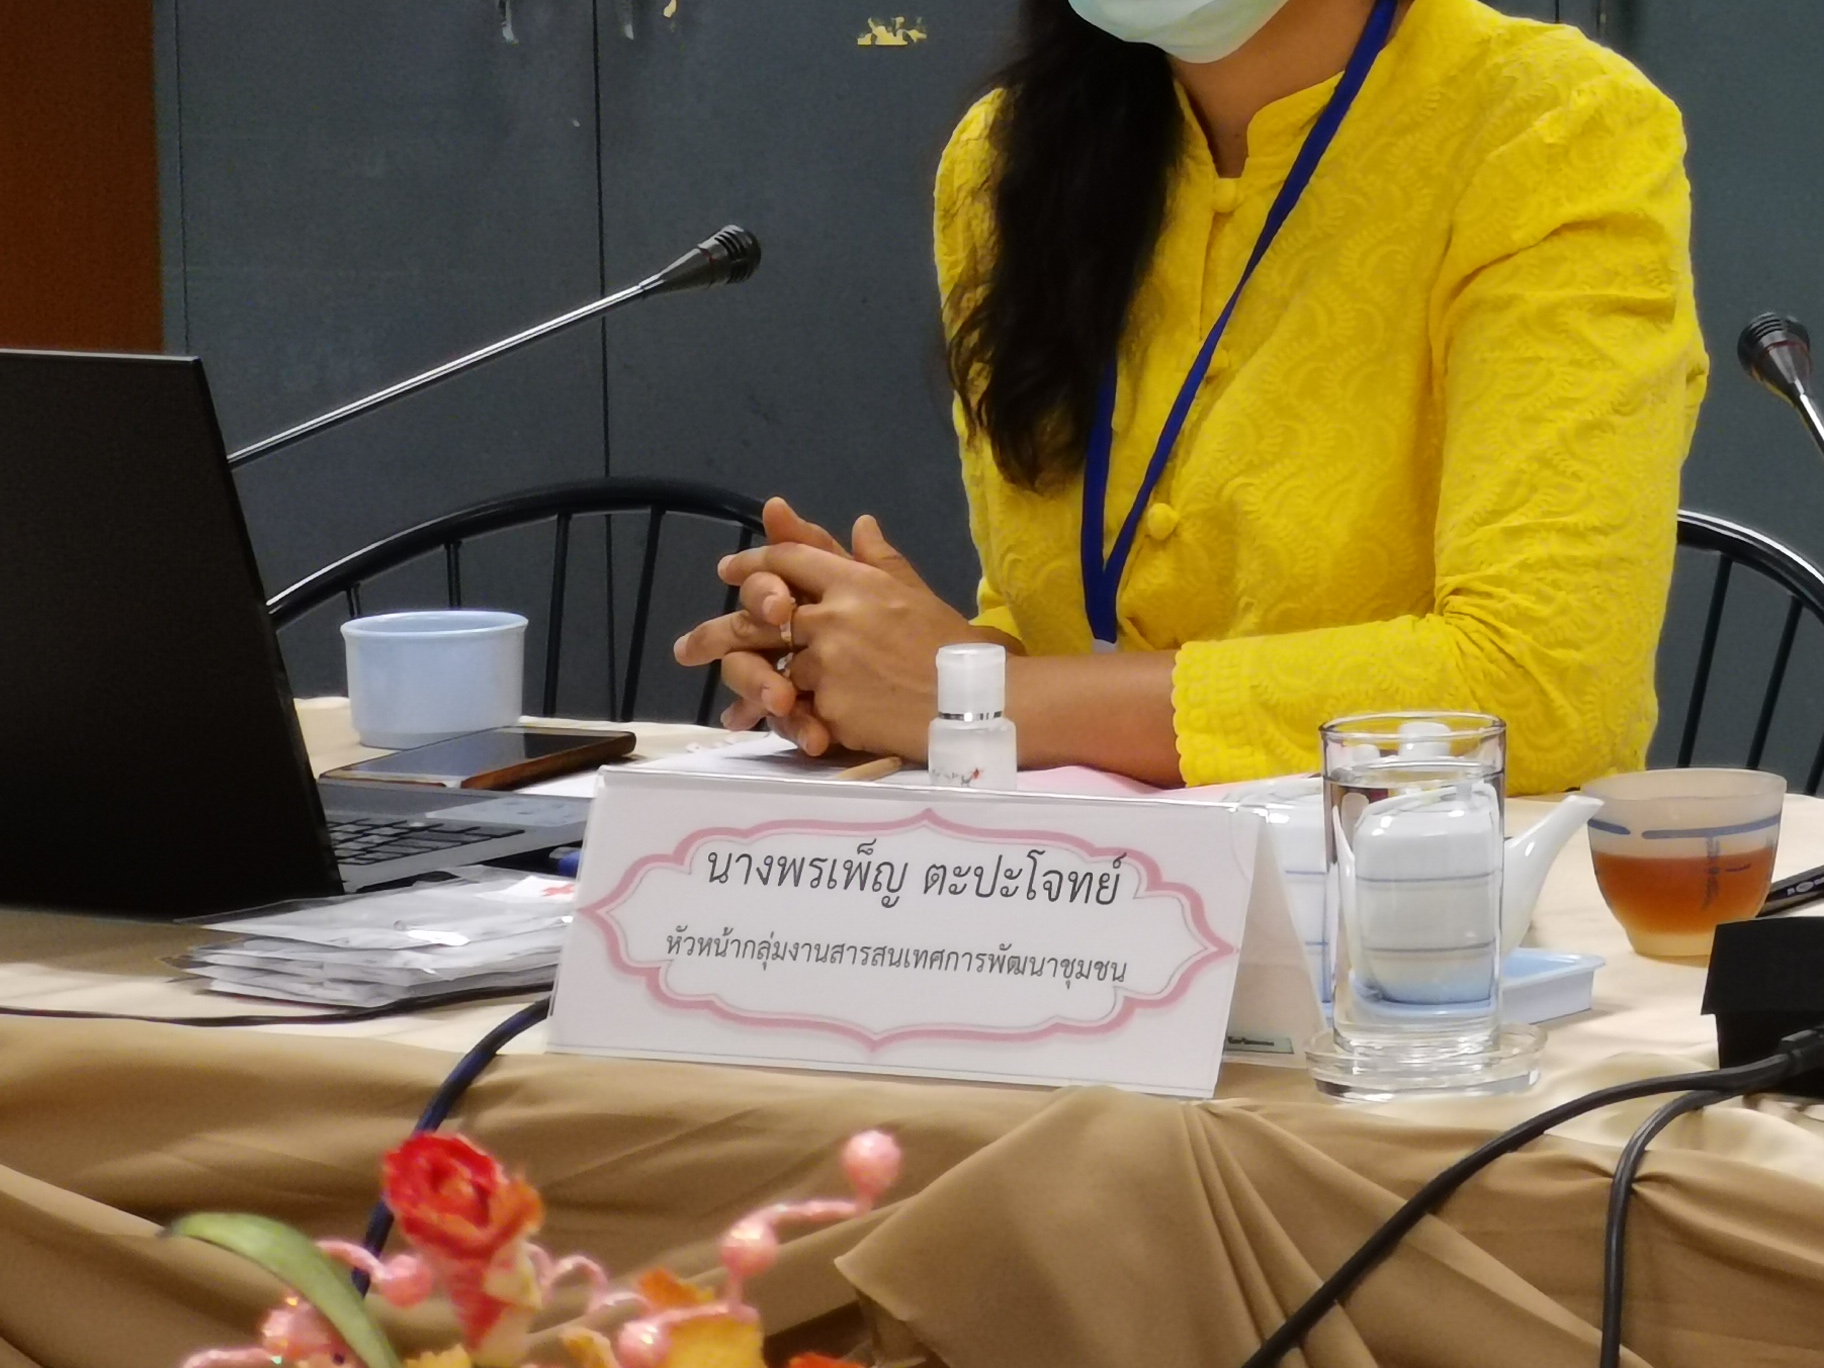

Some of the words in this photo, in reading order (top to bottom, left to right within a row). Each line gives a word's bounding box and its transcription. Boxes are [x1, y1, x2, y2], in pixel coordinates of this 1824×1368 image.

[707, 838, 909, 909] นางพรเพ็ญ
[923, 847, 1128, 906] ตะปะโจทย์
[666, 925, 1128, 990] หัวหน้ากลุ่มงานสารสนเทศการพัฒนาชุมชน
